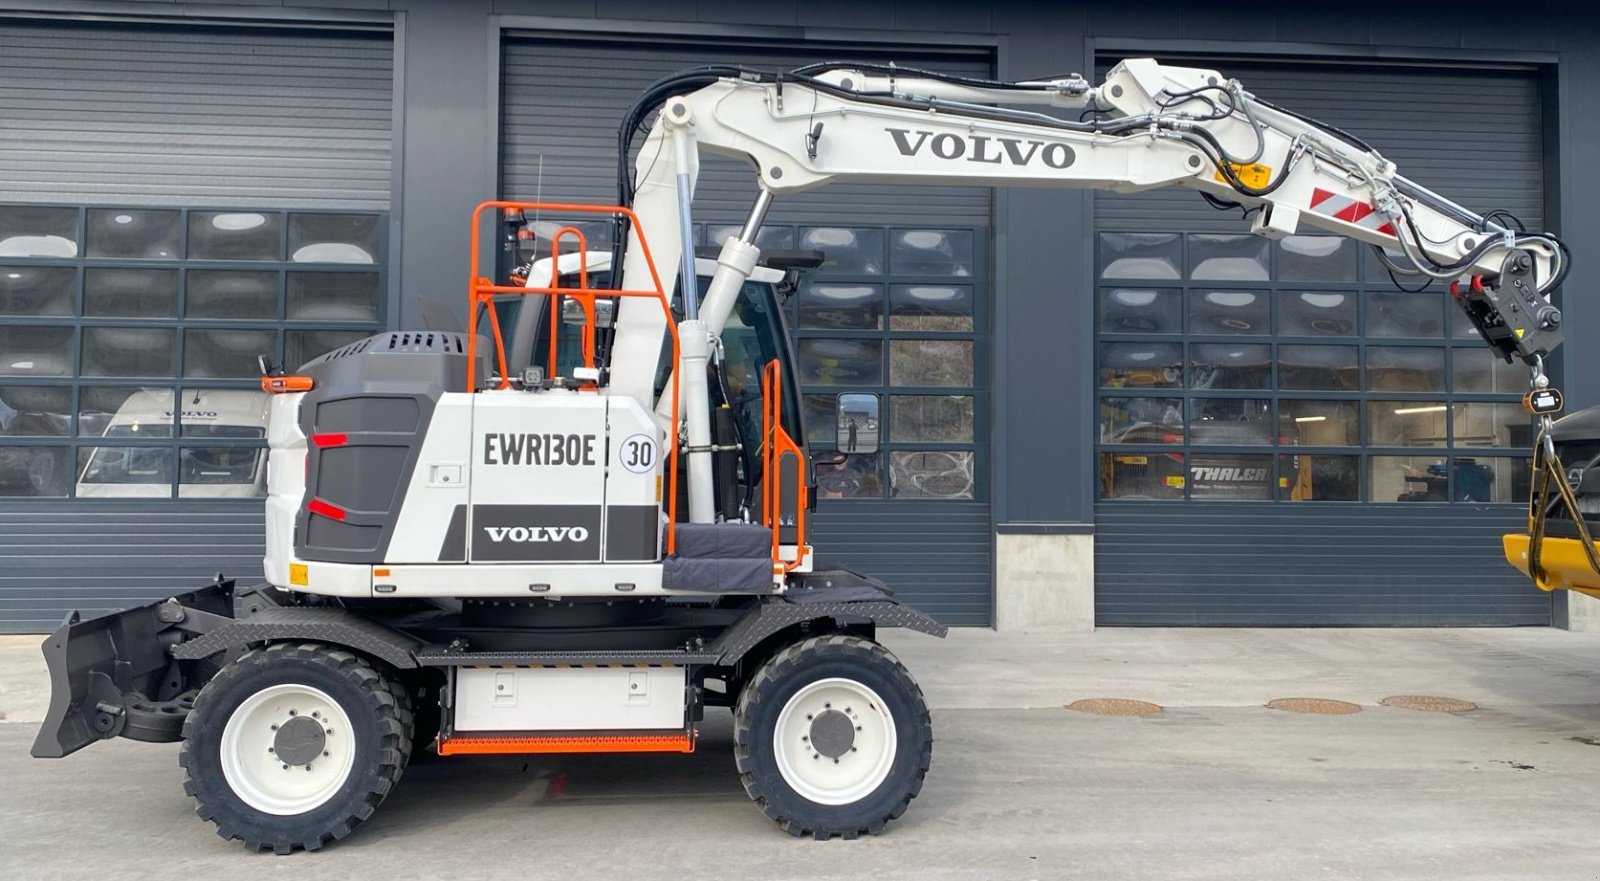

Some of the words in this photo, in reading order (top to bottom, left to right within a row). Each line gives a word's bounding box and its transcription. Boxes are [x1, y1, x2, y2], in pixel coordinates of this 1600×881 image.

[884, 127, 1076, 169] VOLVO
[484, 433, 596, 466] EWR130E
[627, 441, 651, 467] 30
[484, 526, 589, 543] VOLVO
